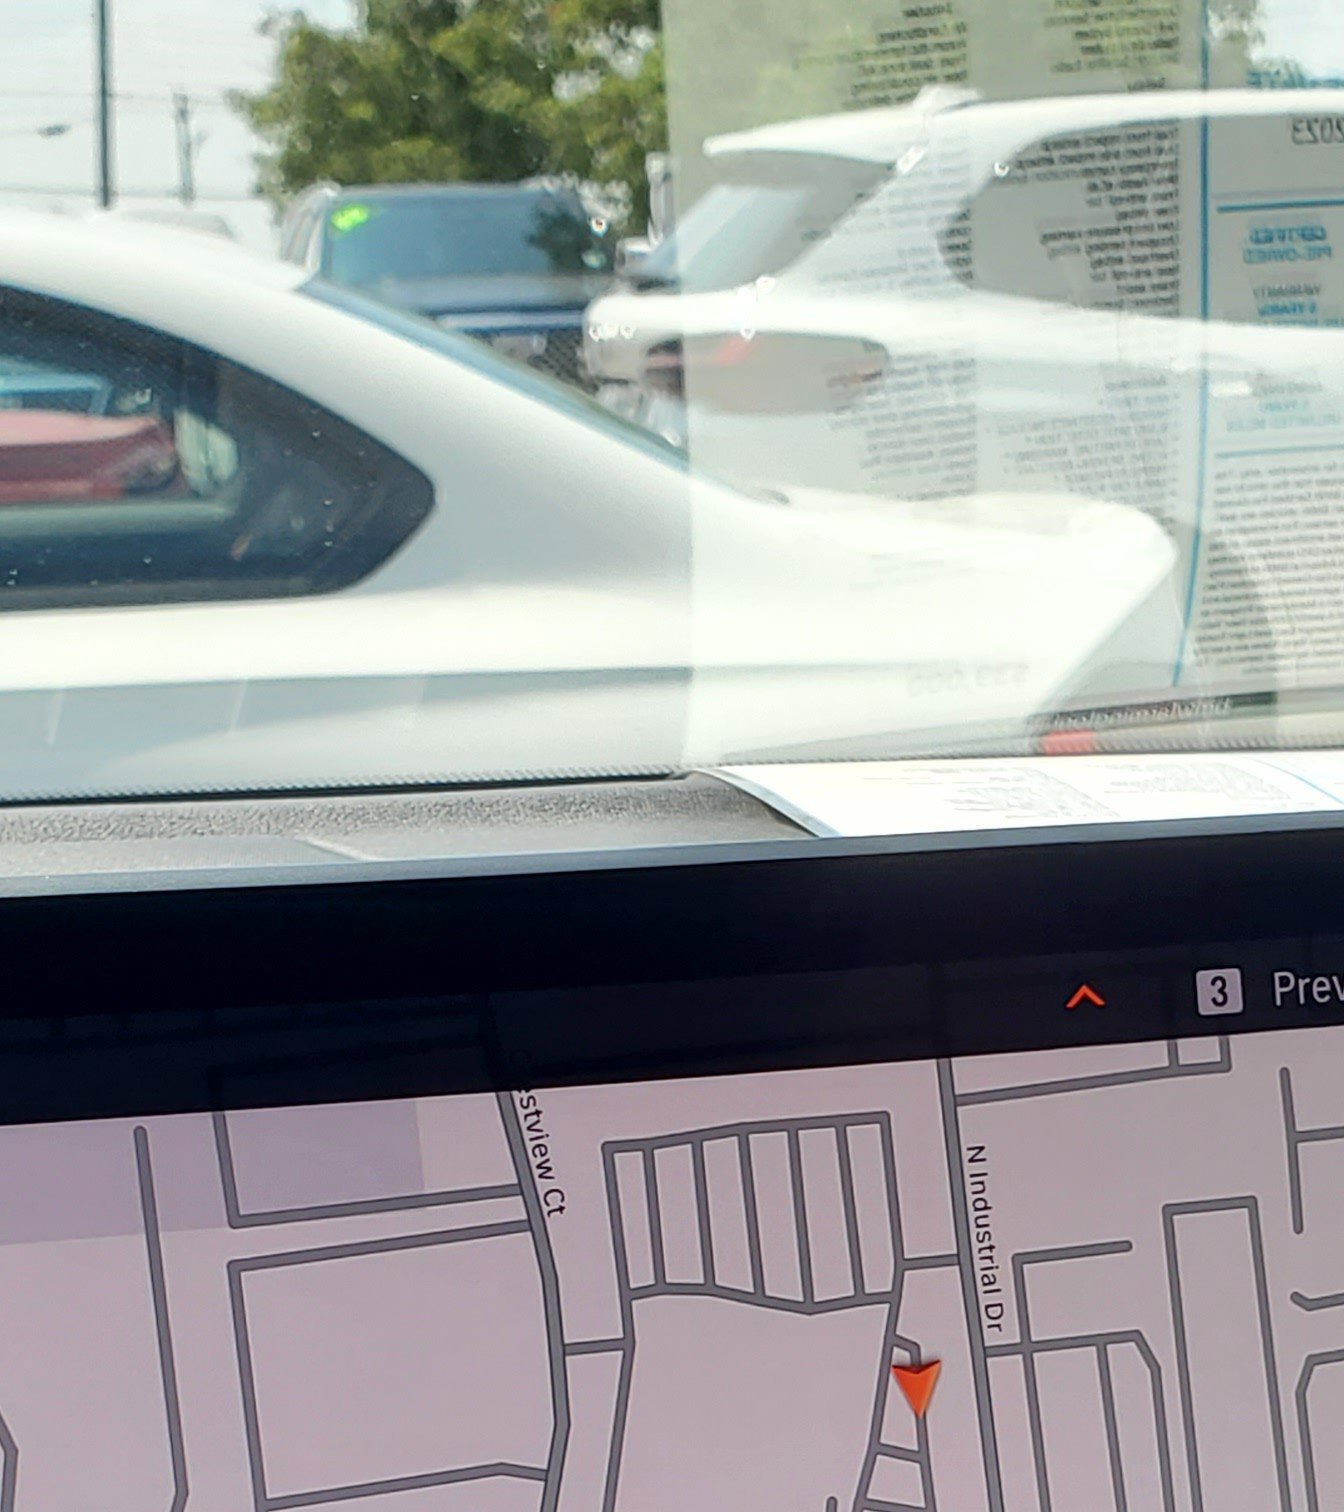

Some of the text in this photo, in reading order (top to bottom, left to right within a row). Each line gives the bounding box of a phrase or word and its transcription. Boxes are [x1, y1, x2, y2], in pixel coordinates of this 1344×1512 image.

[1207, 976, 1231, 1008] 3
[543, 1187, 566, 1217] Ct
[965, 1145, 1005, 1333] N Industrial Dr
